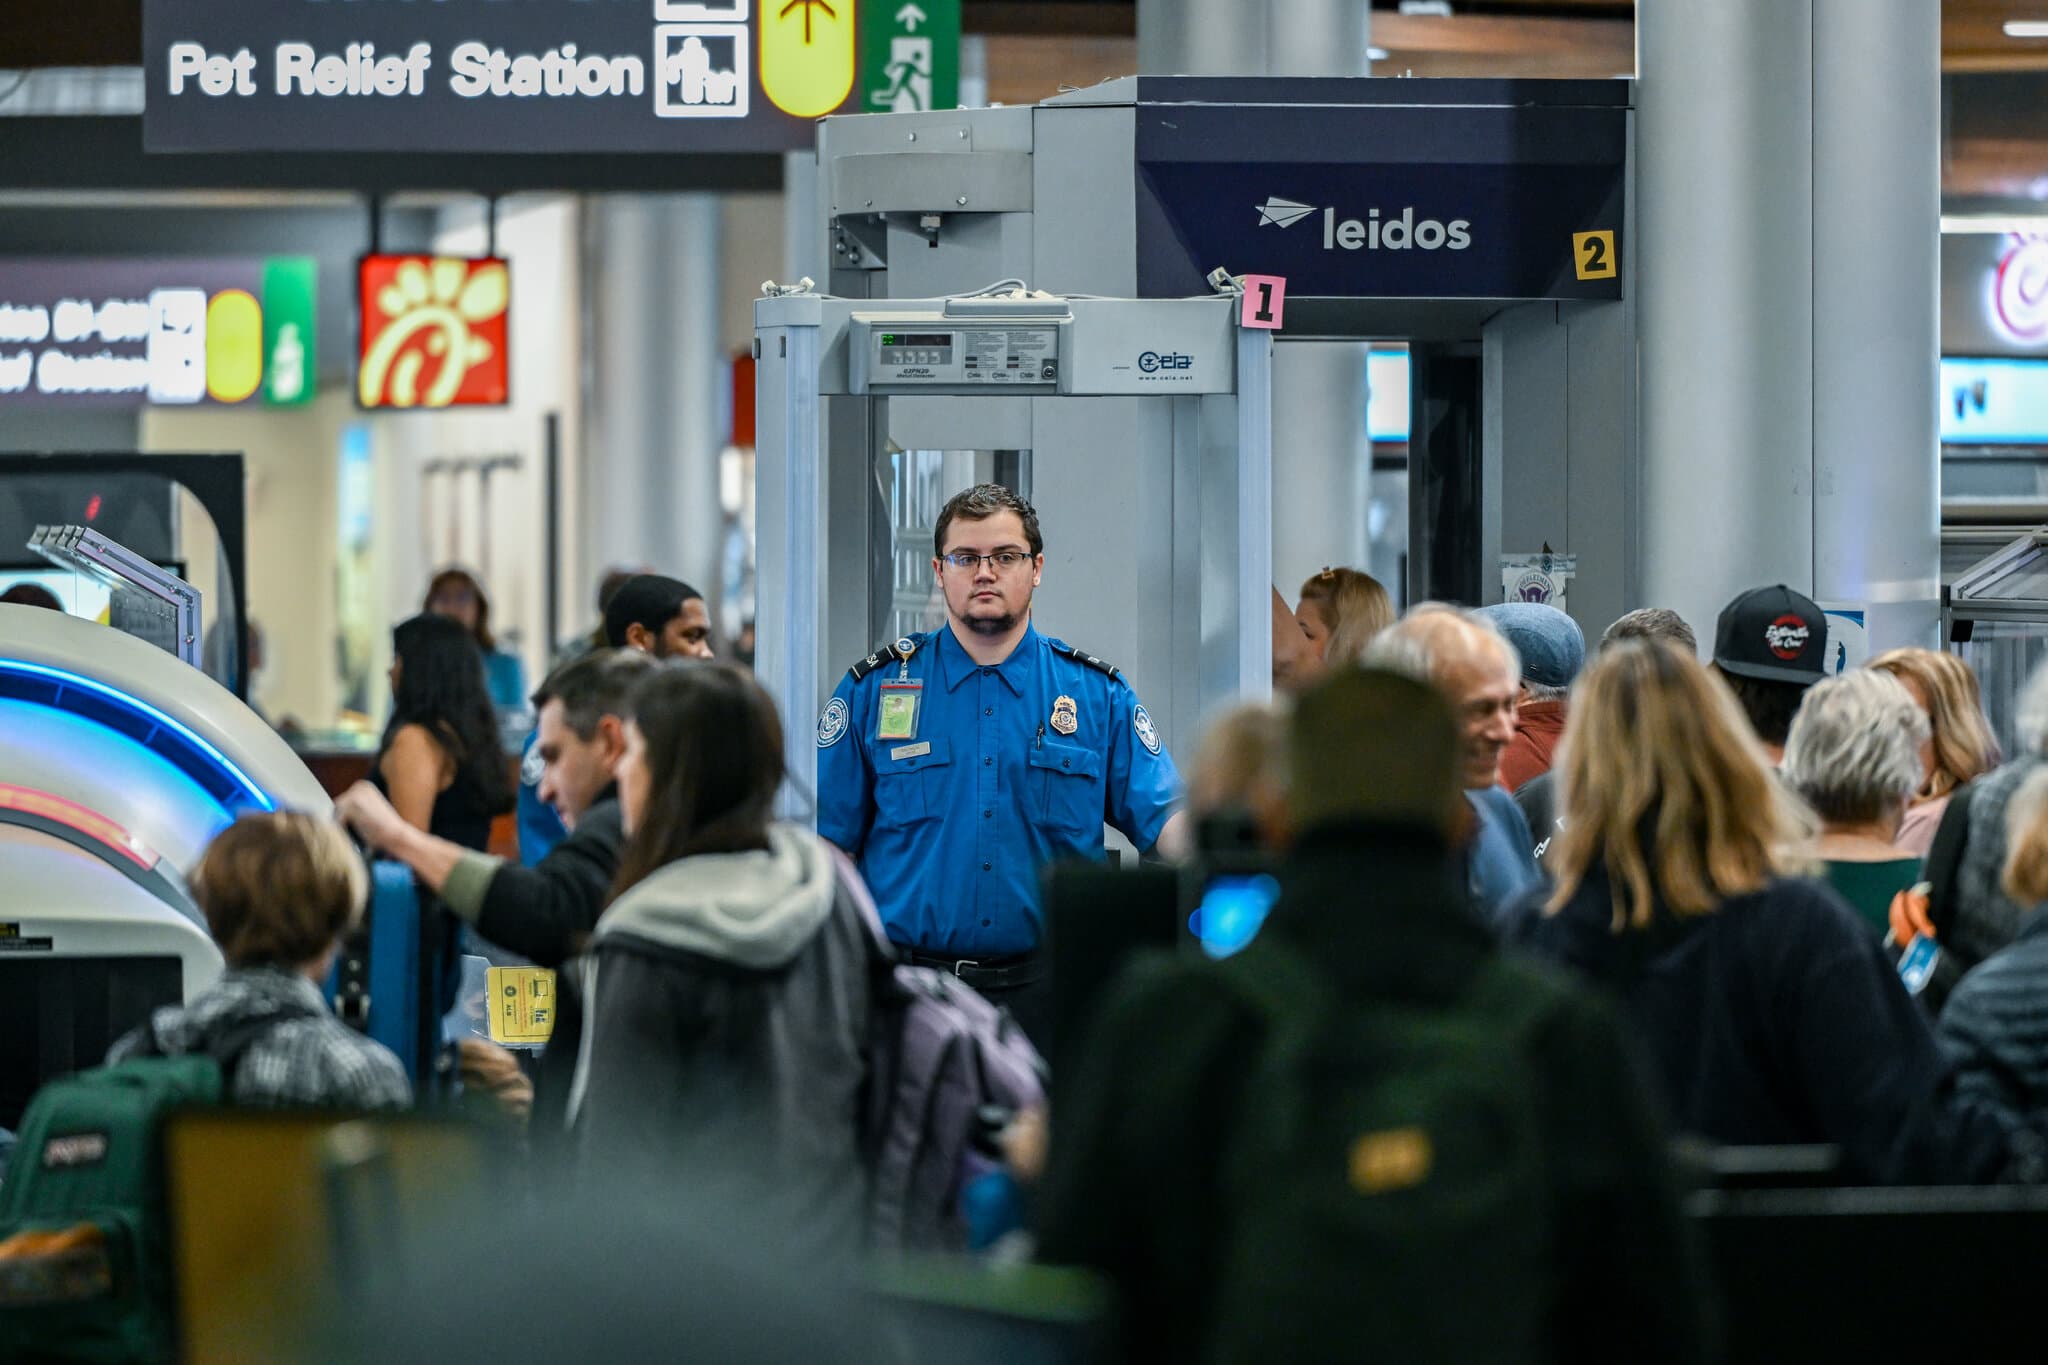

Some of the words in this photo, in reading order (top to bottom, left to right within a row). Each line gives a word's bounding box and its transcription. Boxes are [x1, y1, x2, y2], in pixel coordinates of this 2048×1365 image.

[169, 43, 257, 96] Pet
[276, 43, 432, 96] Relief
[450, 41, 645, 97] Station
[1323, 207, 1472, 250] leidos
[1583, 236, 1607, 272] 2
[1255, 283, 1273, 322] 1
